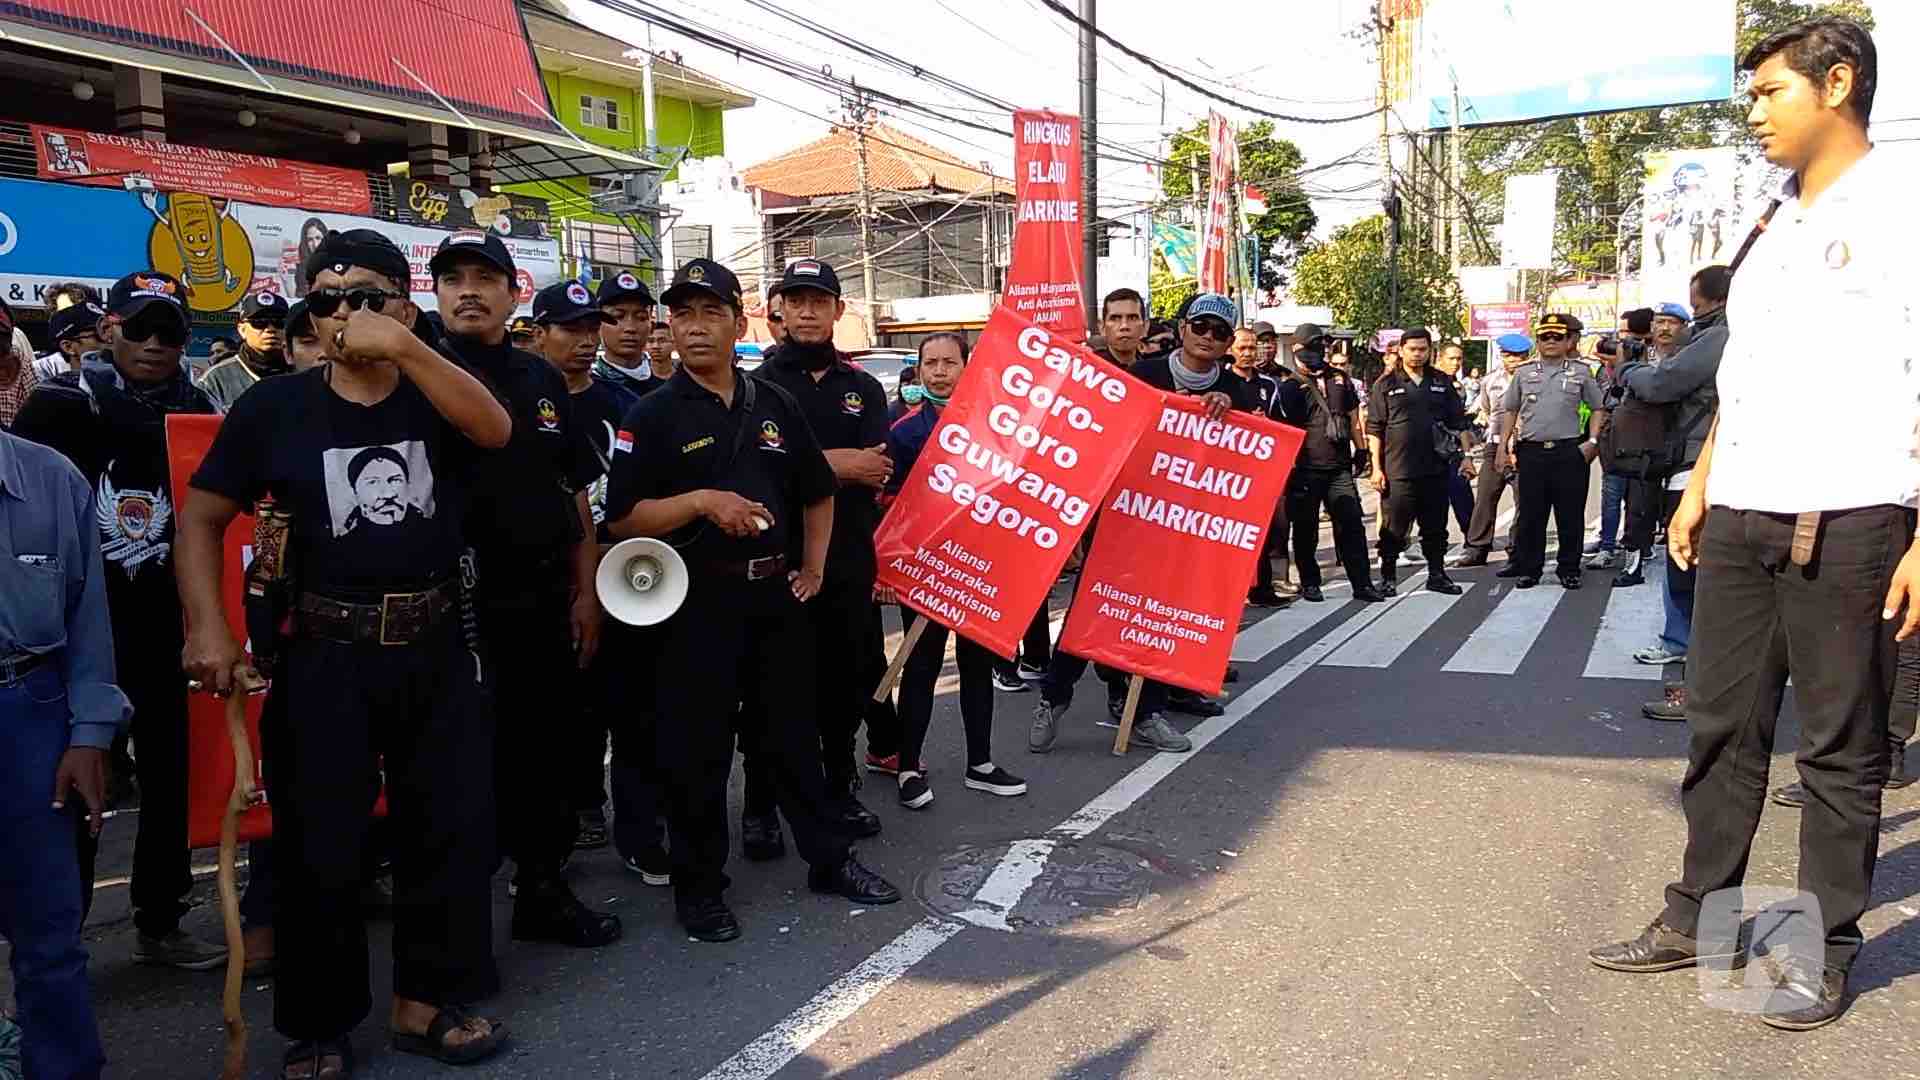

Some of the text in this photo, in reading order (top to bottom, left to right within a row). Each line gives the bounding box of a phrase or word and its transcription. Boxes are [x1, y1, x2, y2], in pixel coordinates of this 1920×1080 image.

[87, 131, 279, 169] SEGERA BERGABUNGLAH
[1024, 119, 1072, 147] RINGKUS
[9, 283, 24, 300] &
[1008, 283, 1039, 297] Aliansi
[1017, 298, 1034, 312] Anti
[1018, 326, 1127, 403] Gawe
[1001, 364, 1104, 433] Goro-
[987, 404, 1078, 470] Goro
[1157, 407, 1275, 460] RINGKUS
[937, 423, 1090, 526] Guwang
[1151, 452, 1252, 501] PELAKU
[928, 463, 1058, 549] Segoro
[1111, 489, 1261, 551] ANARKISME
[914, 546, 998, 599] Masyarakat
[939, 539, 992, 573] Aliansi
[890, 557, 1001, 622] Anti Anarkisme
[908, 586, 966, 627] (AMAN)
[1091, 581, 1225, 631] Aliansi Masyarakat
[1098, 602, 1208, 644] Anti Anarkisme
[1120, 627, 1176, 655] (AMAN)
